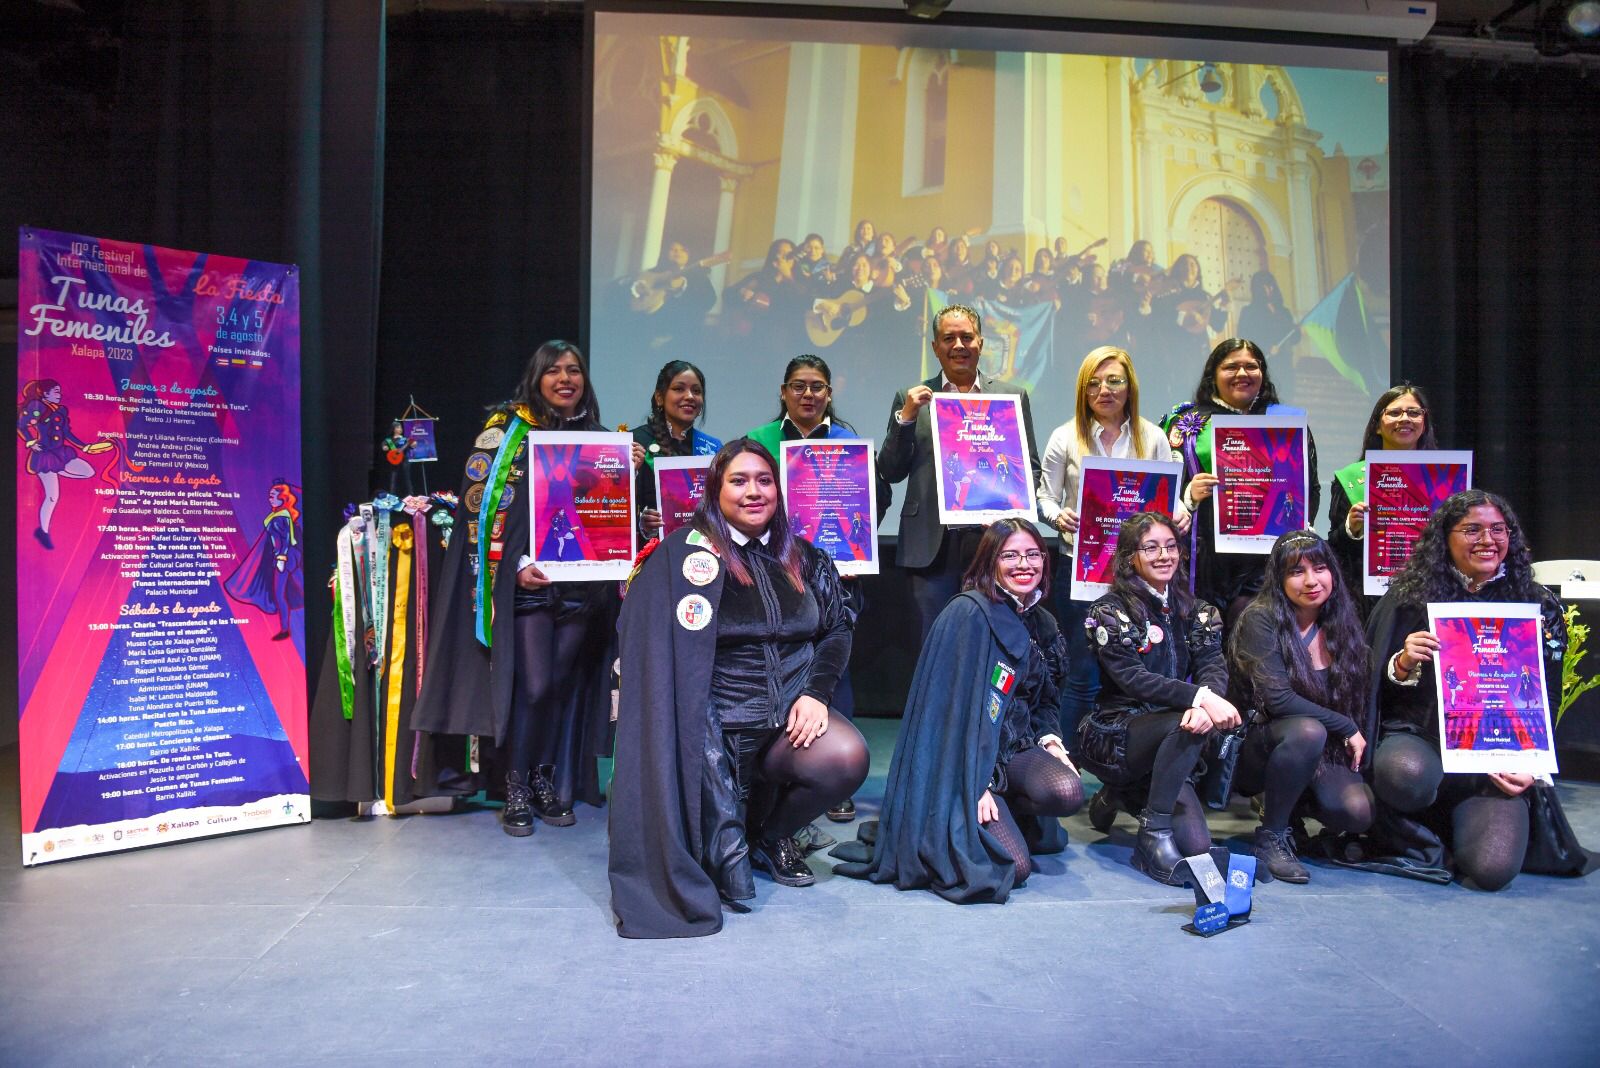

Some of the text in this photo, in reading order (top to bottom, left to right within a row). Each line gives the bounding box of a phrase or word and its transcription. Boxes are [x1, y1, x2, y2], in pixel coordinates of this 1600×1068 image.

[92, 245, 134, 263] Festival
[57, 253, 147, 277] Internacional de
[52, 276, 149, 315] Tunas
[224, 279, 284, 304] Fiesta
[24, 304, 175, 348] Femeniles
[243, 315, 249, 330] y
[255, 311, 264, 328] 5
[216, 327, 262, 342] de agosto
[72, 343, 132, 361] Xalapa 2023
[208, 345, 270, 357] Países invitados:
[120, 379, 157, 392] Jueves
[170, 382, 182, 393] de
[185, 385, 218, 399] agosto
[190, 400, 214, 409] popular
[175, 409, 217, 417] Internacional
[962, 420, 995, 431] Tunas
[956, 429, 1006, 441] Femeniles
[120, 472, 161, 483] Viernes
[173, 472, 186, 483] de
[188, 474, 222, 488] agosto
[140, 490, 176, 498] Proyección
[1112, 493, 1145, 503] Femeniles
[1118, 486, 1139, 497] Tunas
[119, 603, 161, 616] Sábado
[173, 602, 186, 614] de
[187, 602, 221, 618] agosto
[1472, 644, 1508, 653] Femeniles
[1477, 635, 1501, 647] Tunas
[101, 790, 121, 799] 19:00
[123, 788, 144, 797] horas.
[146, 784, 178, 794] Certamen
[190, 780, 209, 788] Tunas
[211, 776, 245, 786] Femeniles.
[171, 820, 199, 829] Xalapa
[207, 816, 237, 824] Cultura
